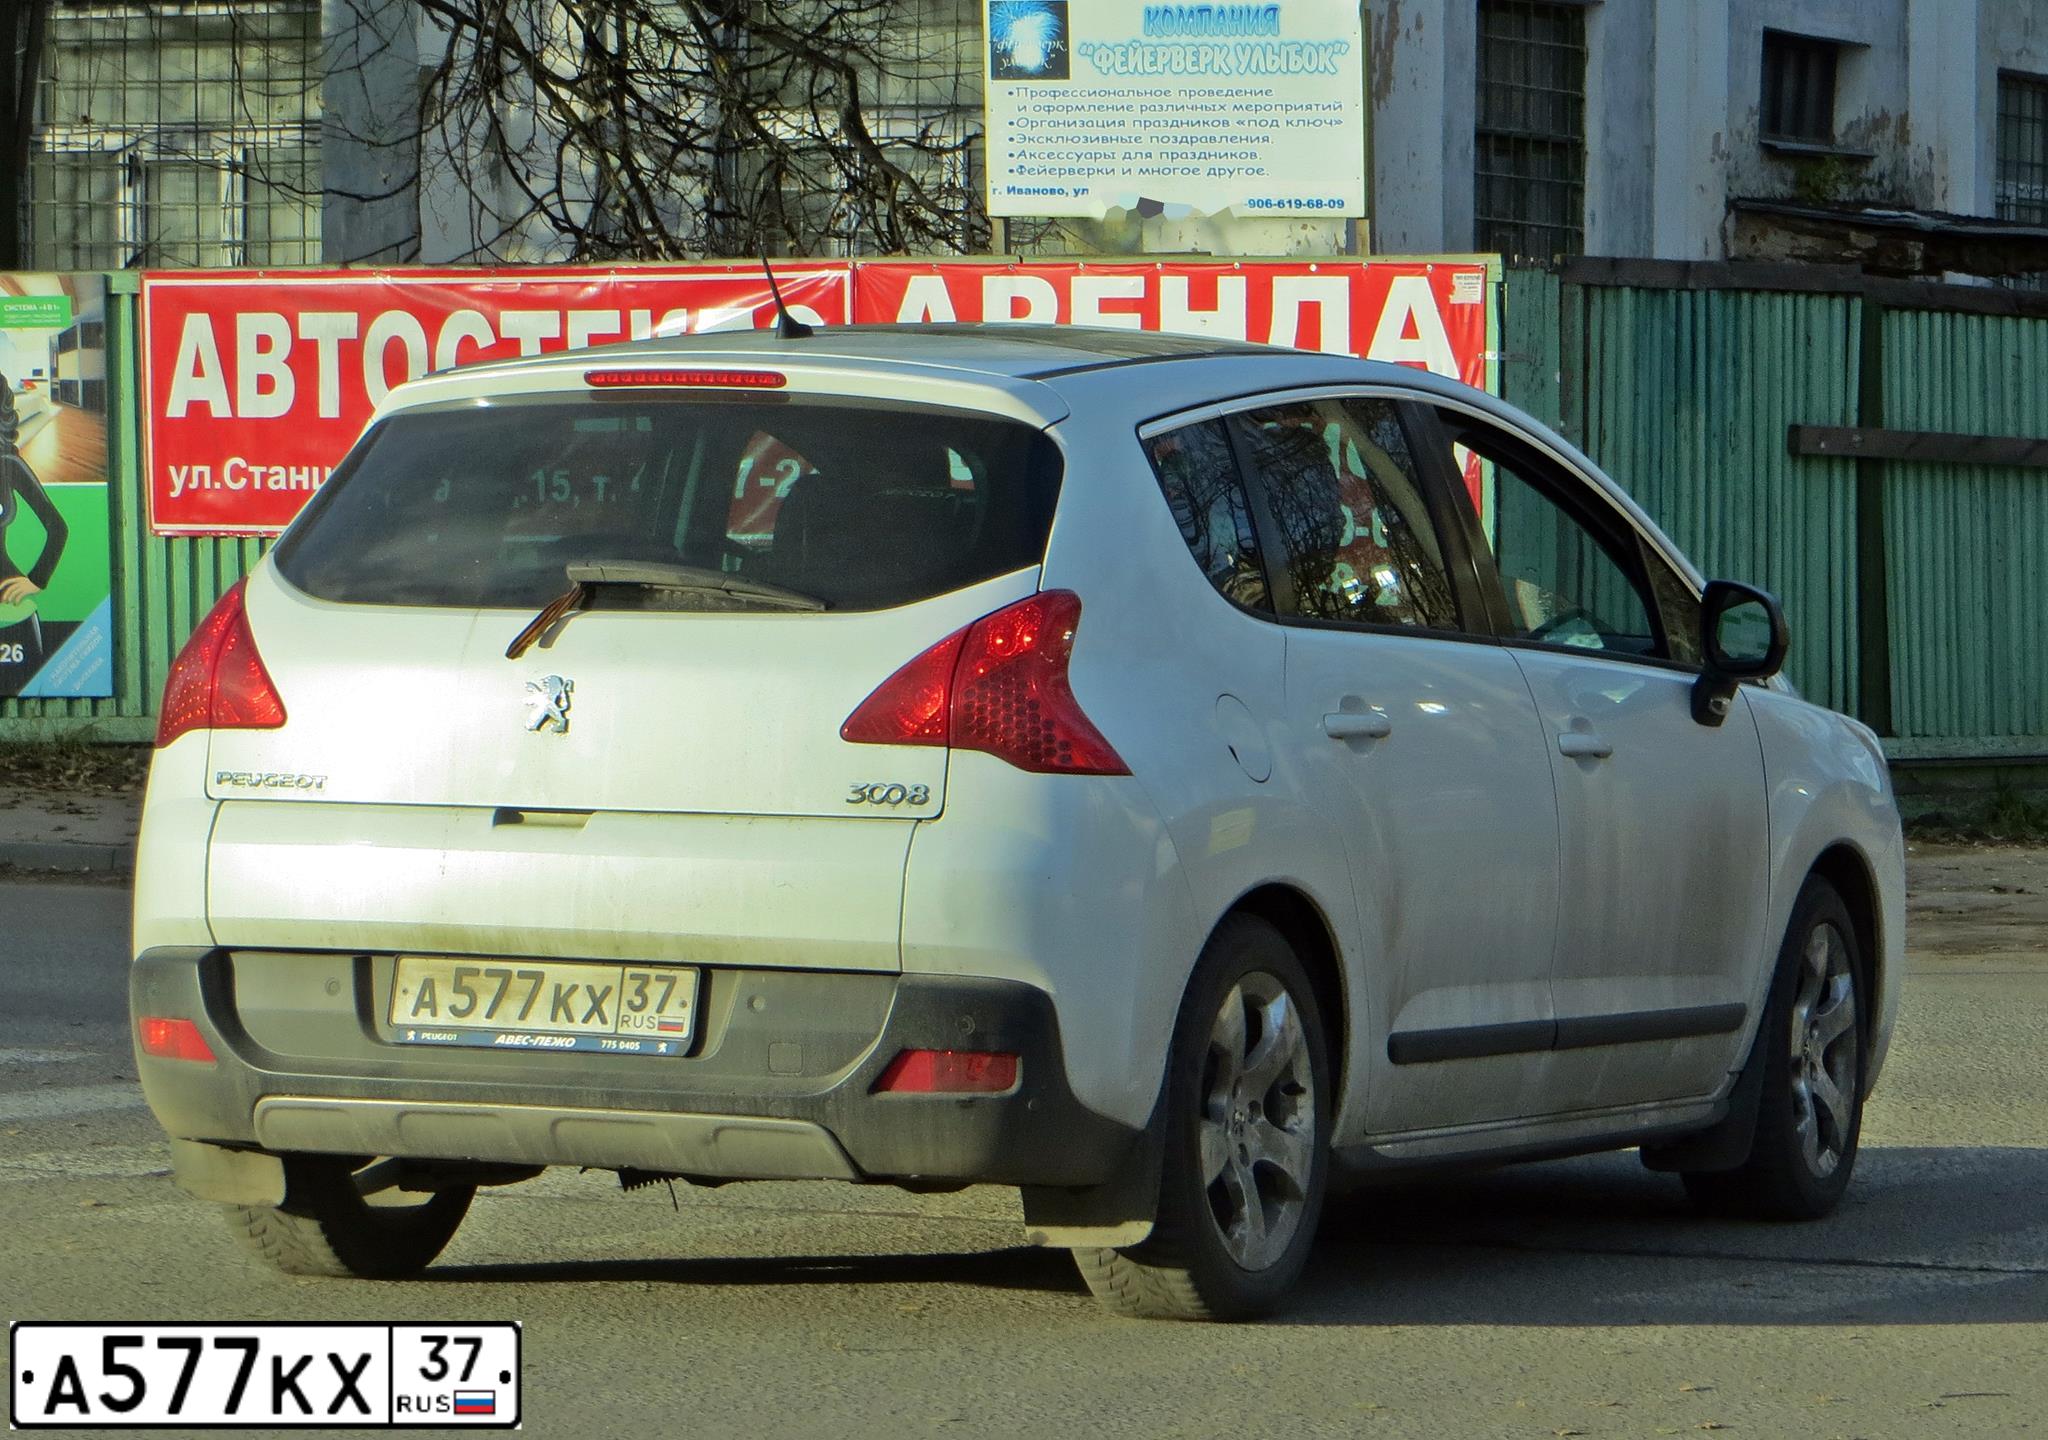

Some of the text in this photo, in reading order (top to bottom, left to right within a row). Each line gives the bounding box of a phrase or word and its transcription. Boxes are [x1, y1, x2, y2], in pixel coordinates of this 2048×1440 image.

[1144, 4, 1281, 37] КОМПАНИЯ
[1015, 86, 1274, 100] Профессиональное проведение
[1017, 101, 1344, 115] и оформление различных мероприятий
[1016, 117, 1344, 131] Организация праздников «под ключ»
[1016, 133, 1275, 146] Эксклюзивные поздравления.
[1016, 149, 1263, 162] Аксессуары для праздников.
[1016, 164, 1270, 178] Фейерверки и многое другое.
[1006, 185, 1069, 197] Иваново,
[165, 303, 824, 418] АВТОС
[216, 771, 328, 789] PEUGEOT
[845, 783, 930, 806] 3008
[627, 972, 678, 1014] 37
[620, 1015, 656, 1029] RUS
[421, 1032, 458, 1042] PEUGEOT
[494, 1034, 576, 1048] АВЕС-ПЕЖО
[601, 1039, 618, 1050] 775
